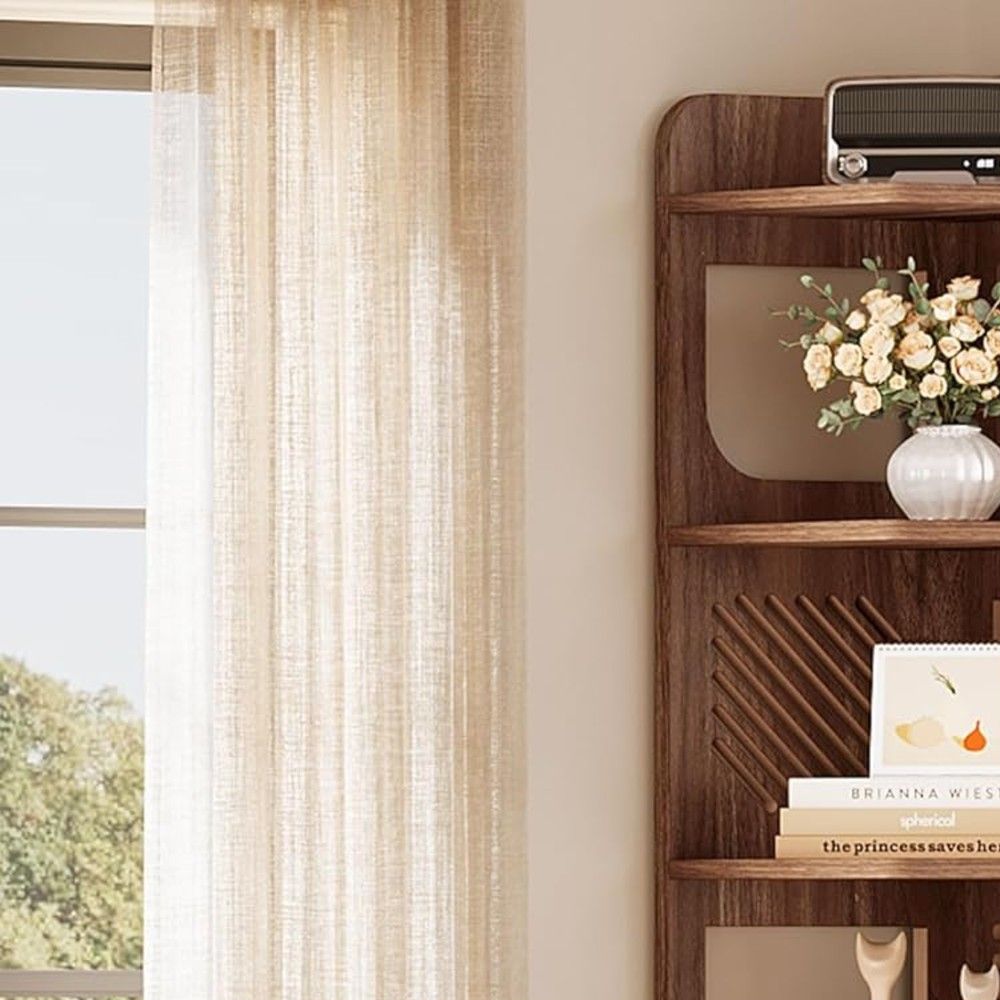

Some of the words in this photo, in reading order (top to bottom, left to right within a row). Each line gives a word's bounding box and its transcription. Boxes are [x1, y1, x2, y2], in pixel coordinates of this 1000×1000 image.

[851, 787, 938, 800] BRIANNA
[823, 839, 851, 853] the
[854, 839, 926, 856] princess
[928, 842, 975, 853] saves
